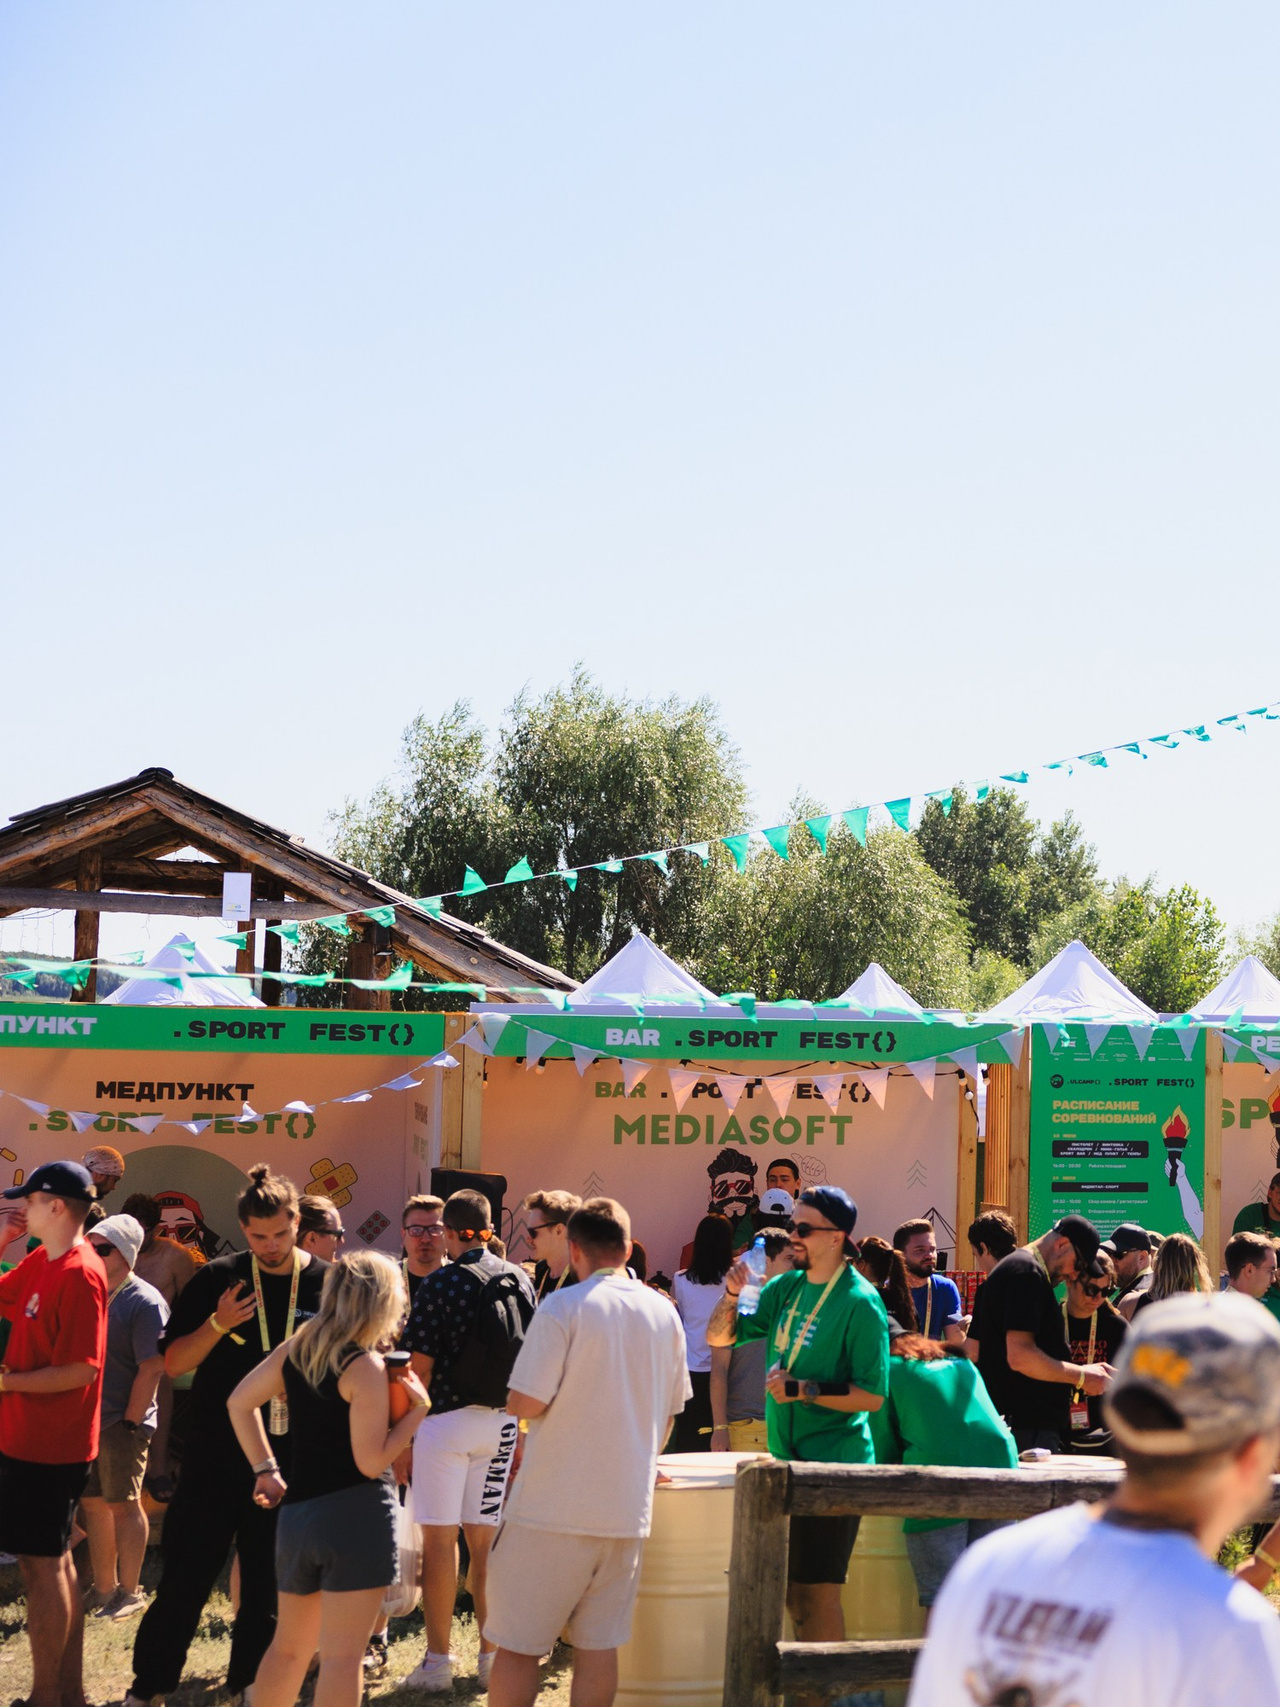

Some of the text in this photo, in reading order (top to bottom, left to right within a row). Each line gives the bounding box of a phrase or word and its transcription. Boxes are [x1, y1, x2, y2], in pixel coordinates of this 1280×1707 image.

[174, 1020, 415, 1046] .SPORT FEST{}
[605, 1028, 897, 1053] BAR .SPORT FEST{}
[96, 1081, 254, 1102] МЕДПУНКТ
[1052, 1100, 1140, 1111] РАСПИСАНИЕ
[1052, 1112, 1157, 1124] СОРЕВНОВАНИЙ
[614, 1114, 853, 1146] MEDIASOFT
